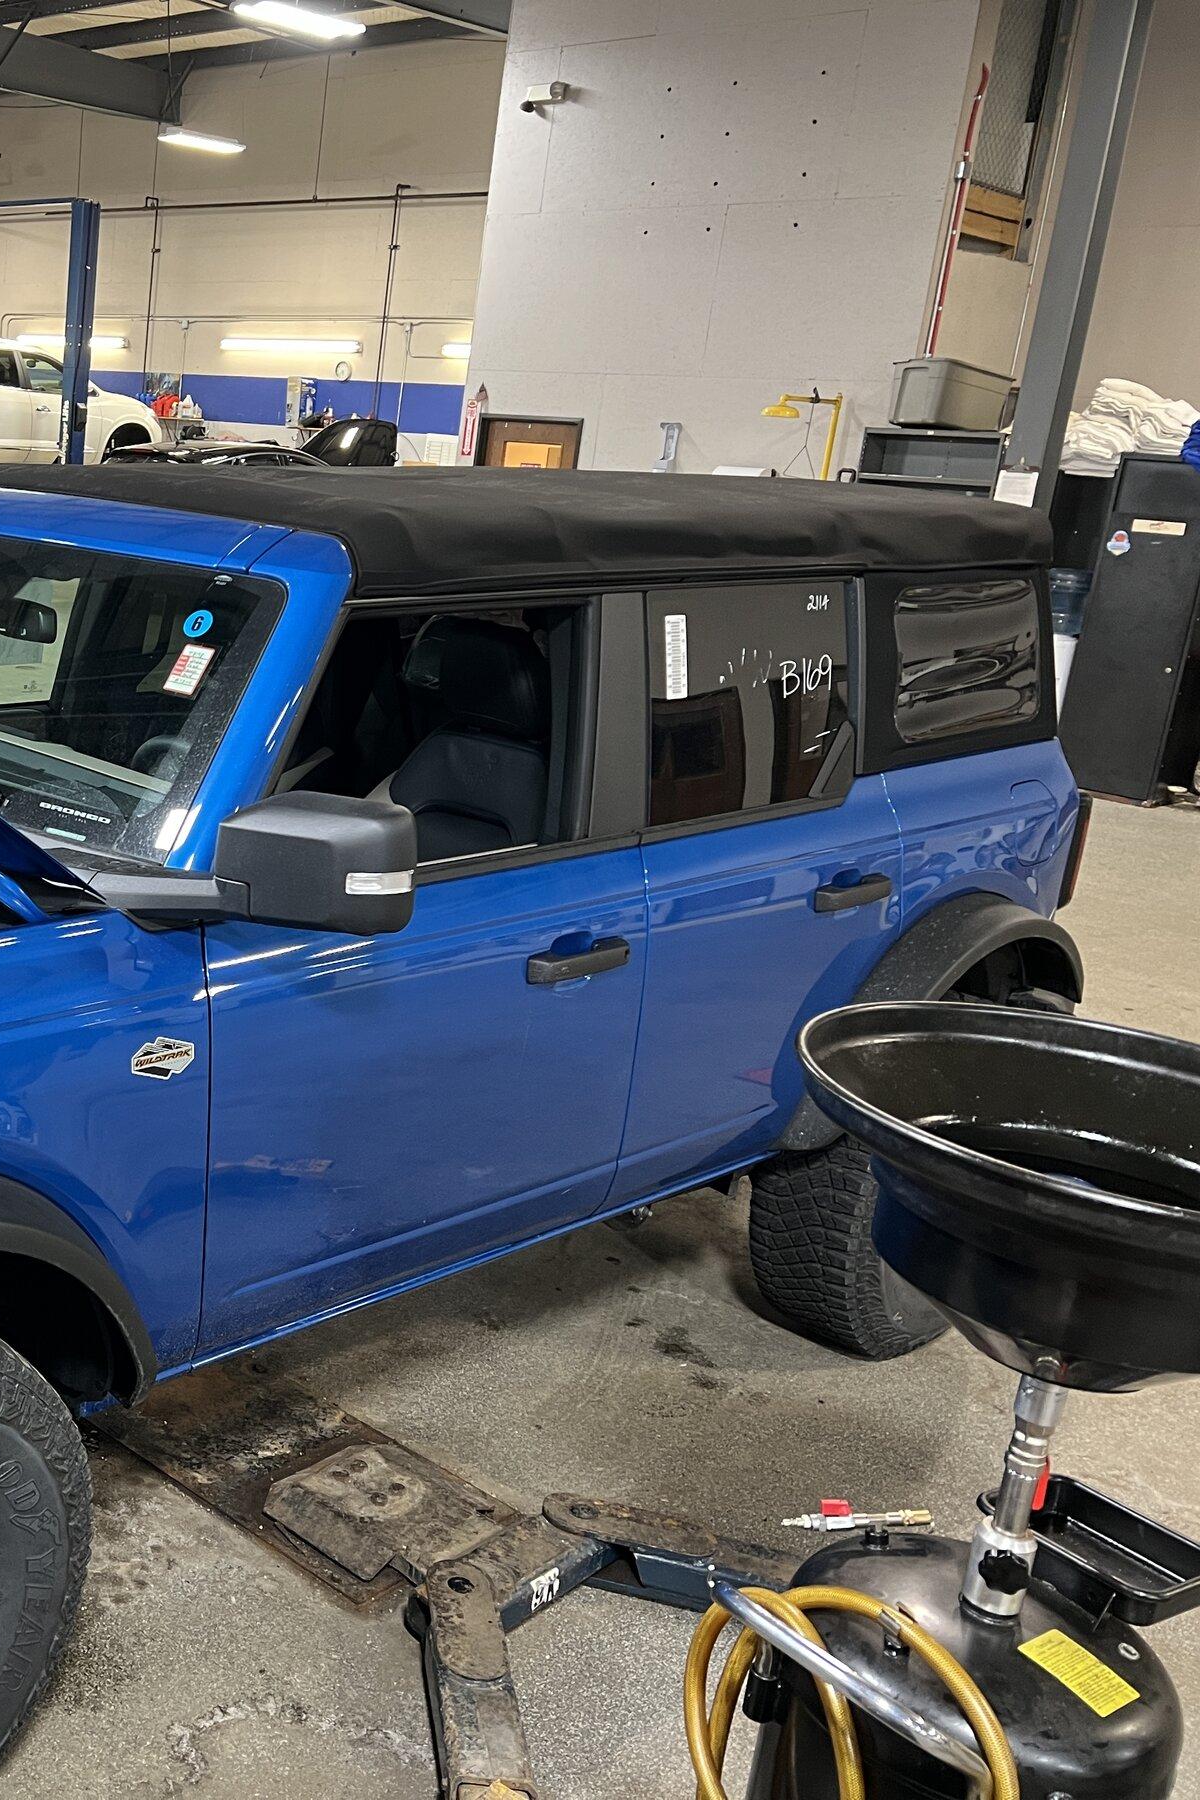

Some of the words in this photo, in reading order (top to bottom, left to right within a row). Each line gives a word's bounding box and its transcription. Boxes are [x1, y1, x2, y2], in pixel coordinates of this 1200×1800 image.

[191, 615, 205, 632] 6
[779, 654, 833, 699] B169
[39, 801, 111, 825] BRONCO
[135, 1048, 191, 1068] WILDTRAK
